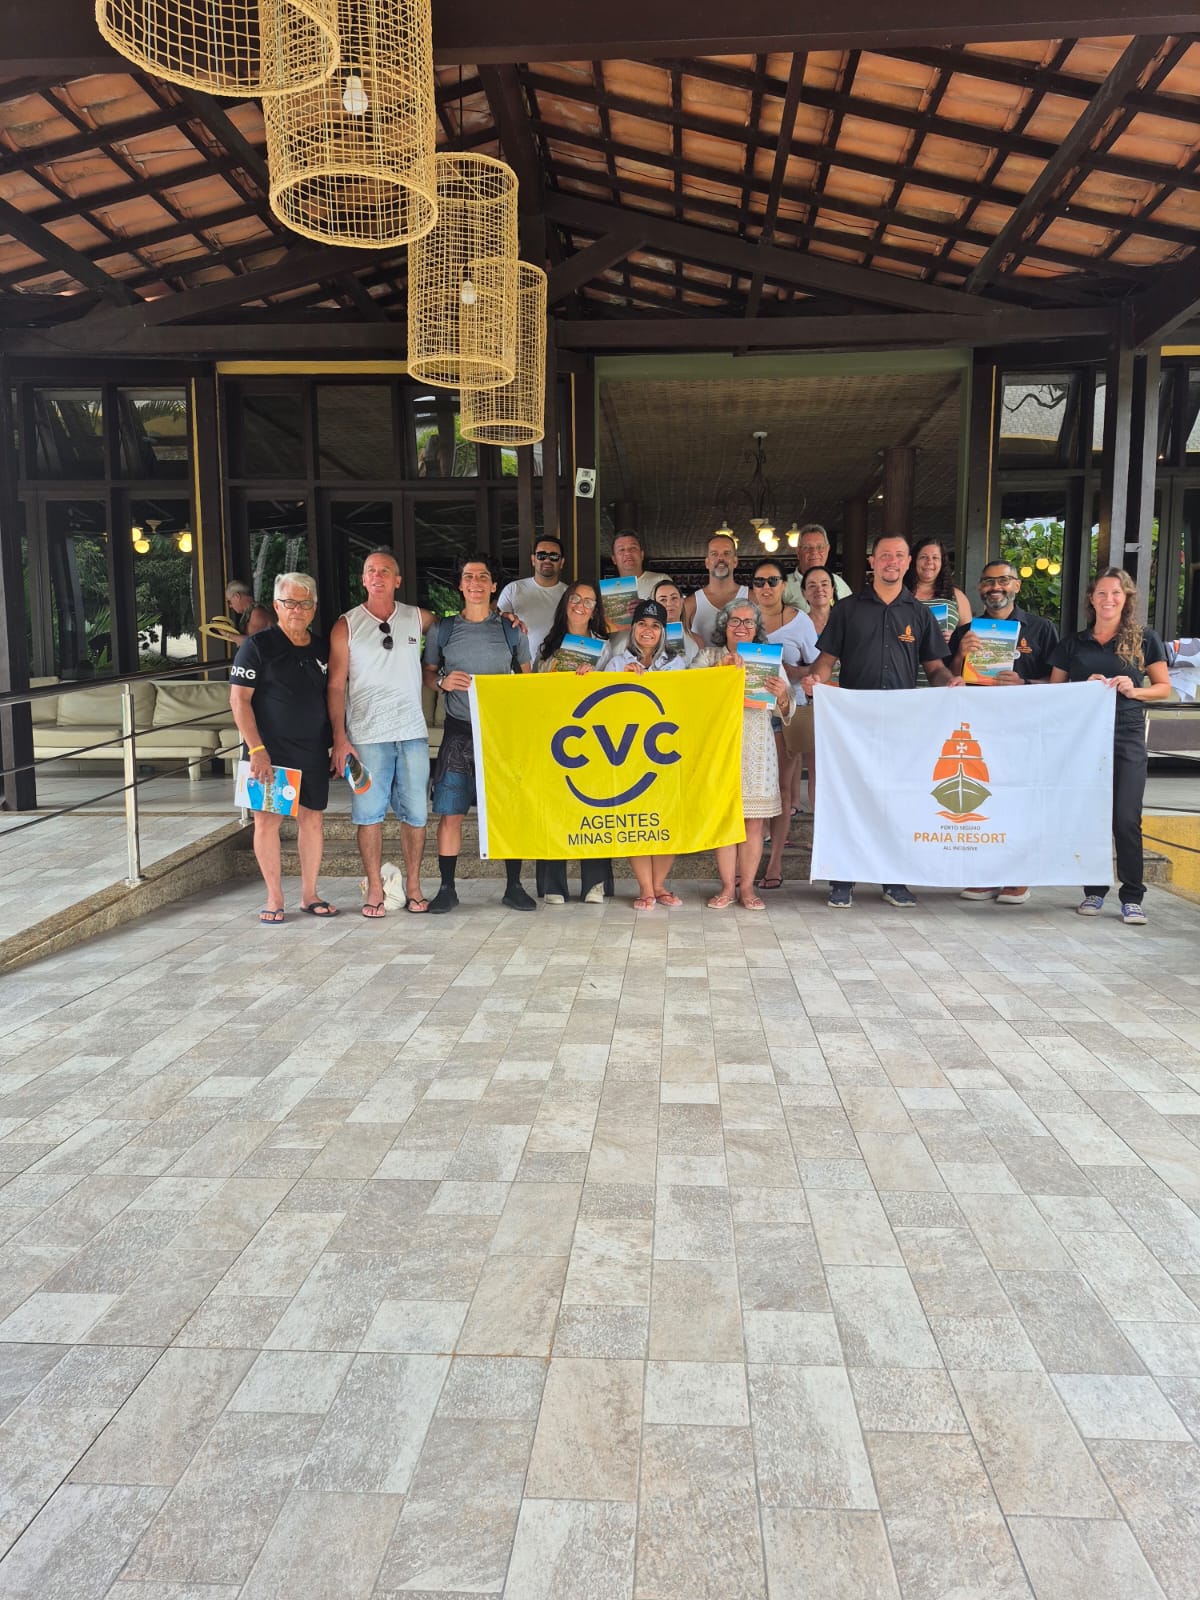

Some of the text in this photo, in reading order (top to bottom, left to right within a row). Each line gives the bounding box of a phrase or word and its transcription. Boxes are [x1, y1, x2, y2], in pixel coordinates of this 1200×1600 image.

[551, 722, 682, 769] CVC
[580, 812, 660, 830] AGENTES
[568, 829, 670, 846] MINAS GERAIS
[913, 831, 1007, 844] PRAIA RESORT
